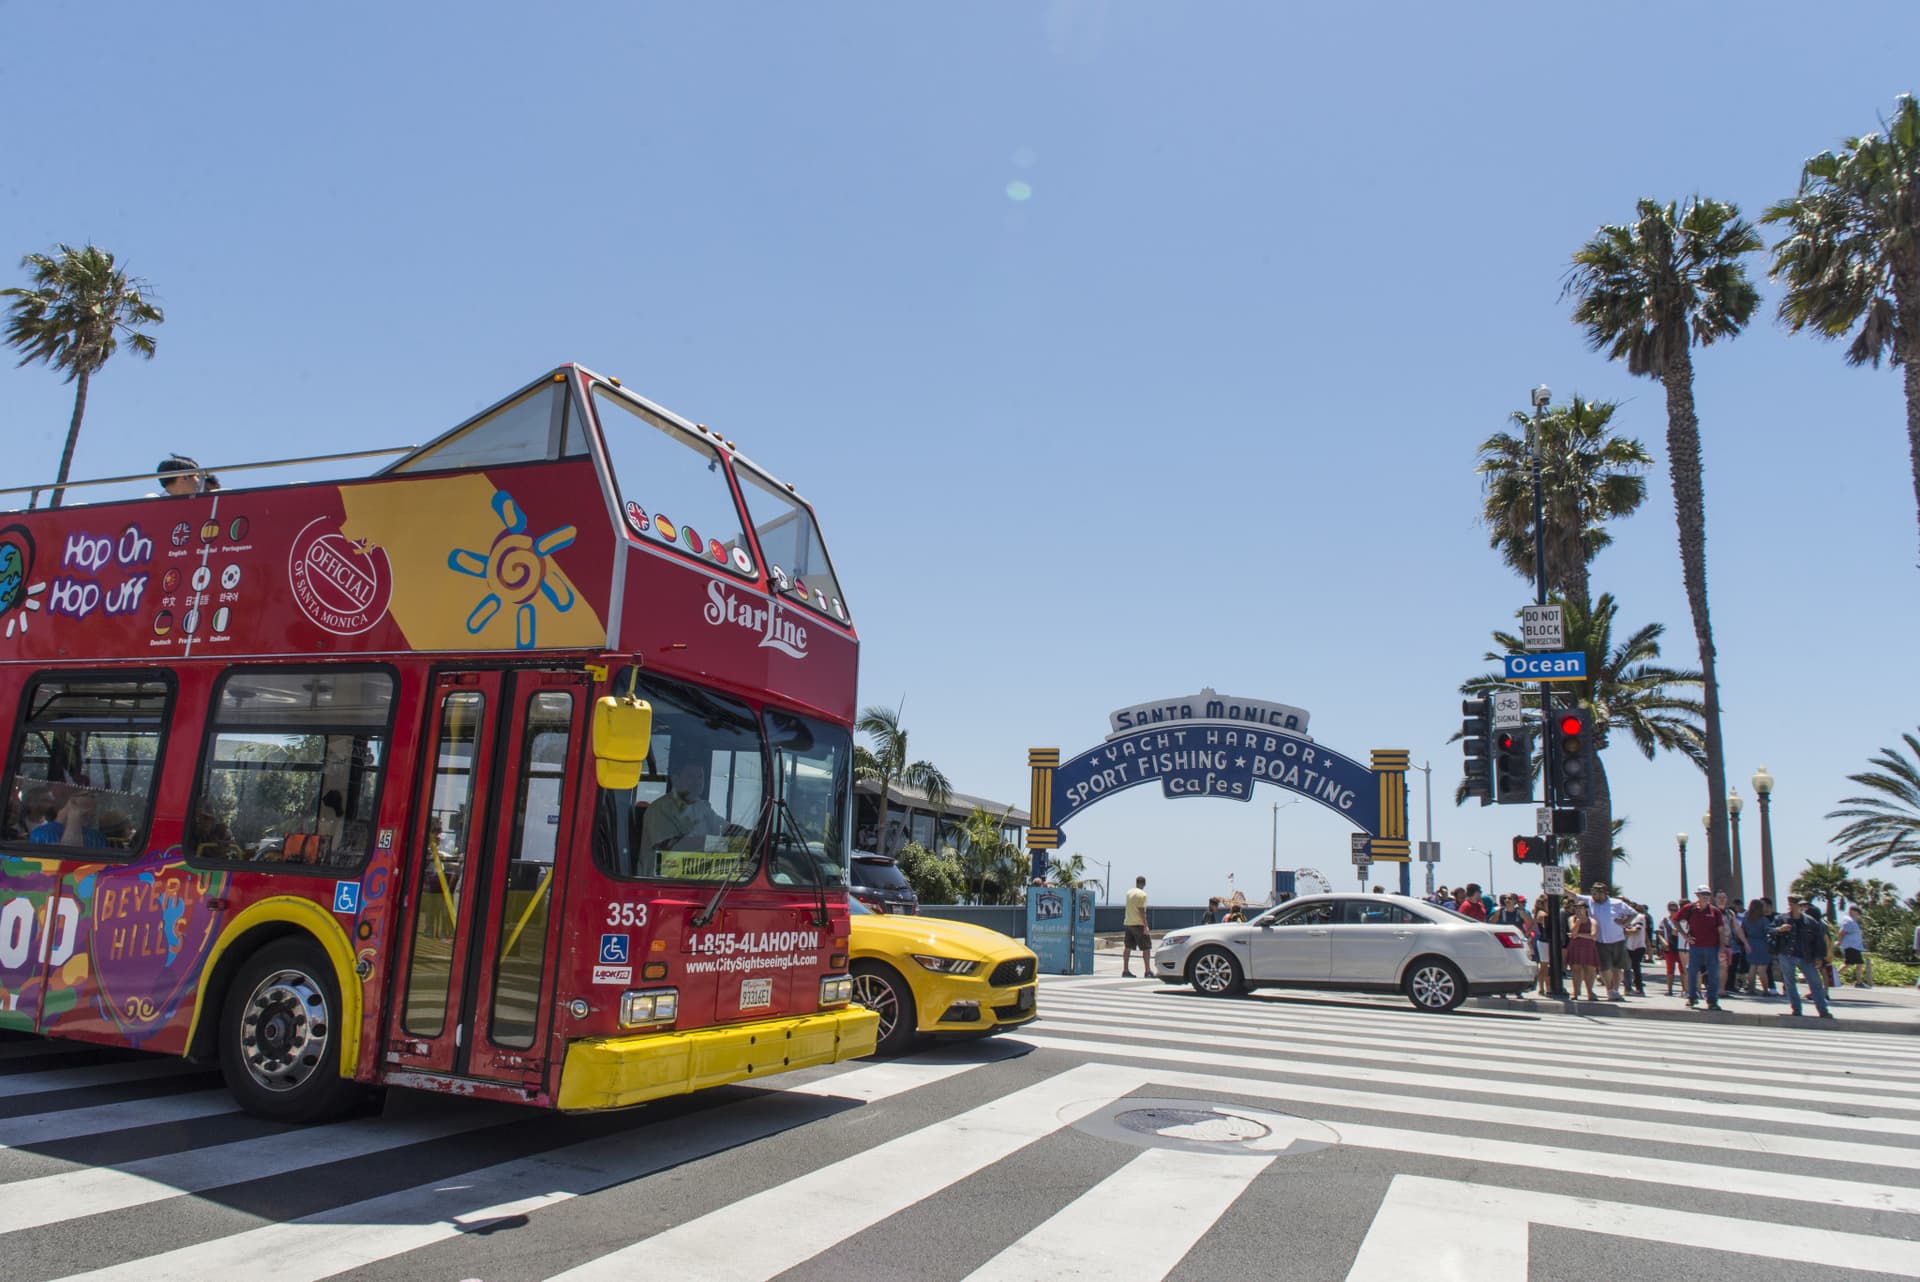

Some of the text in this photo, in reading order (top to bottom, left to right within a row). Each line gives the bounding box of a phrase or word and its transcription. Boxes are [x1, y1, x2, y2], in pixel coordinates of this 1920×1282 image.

[64, 527, 152, 571] Hop On
[311, 545, 370, 604] OFFICIAL
[50, 580, 99, 617] Hop
[295, 560, 368, 629] OF SANTA MONICA
[1525, 610, 1559, 622] DO NOT
[1526, 625, 1560, 636] BLOCK
[1526, 637, 1561, 645] INTERSECTION
[1511, 658, 1579, 673] Ocean
[1117, 701, 1298, 731] SANTA MONICA
[1105, 730, 1316, 764] YACHT HARBOR
[1066, 750, 1356, 809] SPORT FISHING BOATING
[682, 856, 713, 875] YELLOW
[606, 902, 647, 926] 353
[110, 918, 187, 960] HILLS
[688, 931, 818, 956] 1-855-4LAHOPON
[686, 953, 818, 973] www.CitySightseeingLA.com
